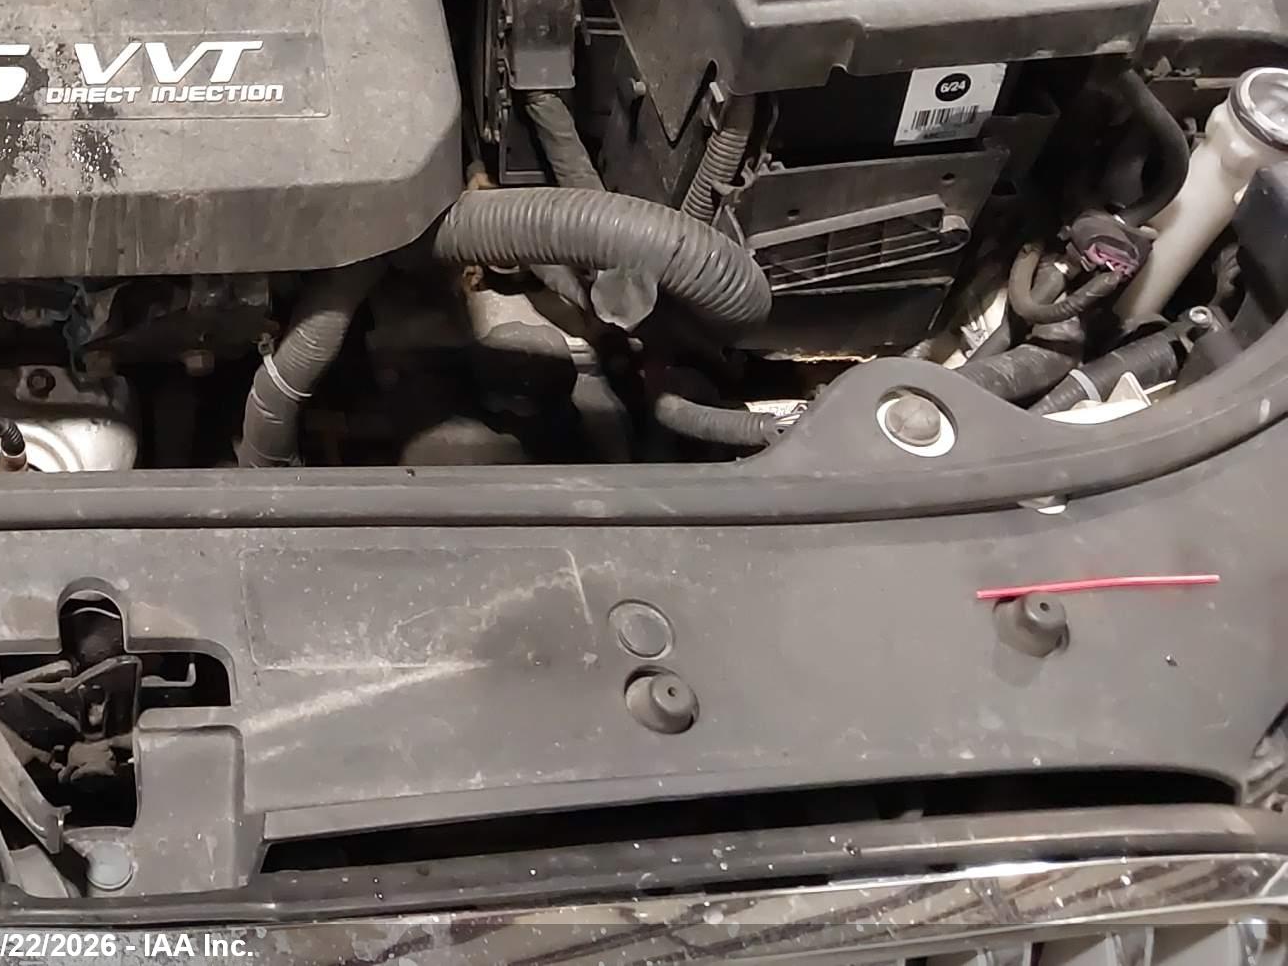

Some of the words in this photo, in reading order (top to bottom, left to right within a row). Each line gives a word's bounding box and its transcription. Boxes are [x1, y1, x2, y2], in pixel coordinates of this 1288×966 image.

[73, 41, 264, 85] VVT
[45, 86, 141, 104] DIRECT
[150, 83, 284, 103] INJECTION
[940, 80, 966, 93] 6/24
